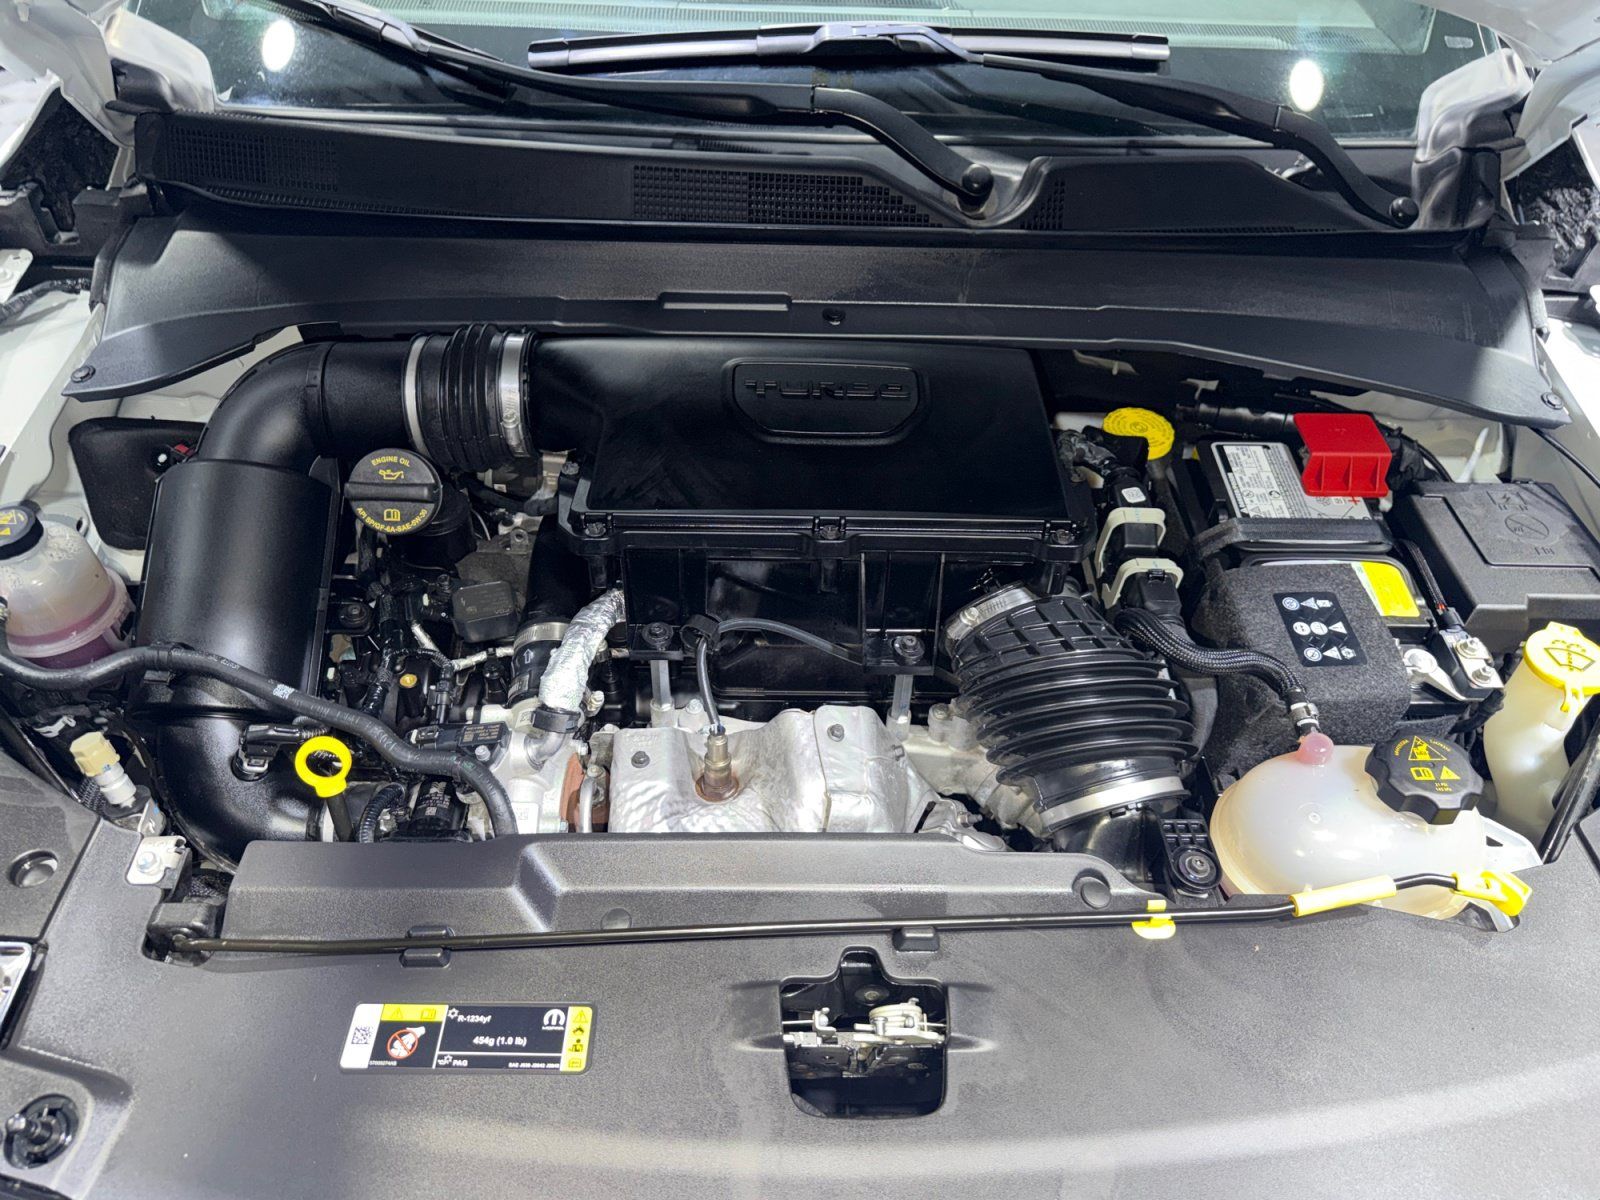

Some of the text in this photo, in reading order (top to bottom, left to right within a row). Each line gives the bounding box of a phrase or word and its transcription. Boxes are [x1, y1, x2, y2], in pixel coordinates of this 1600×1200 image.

[744, 379, 911, 401] TURBO
[371, 456, 410, 467] ENGINE OIL
[356, 507, 368, 519] API
[457, 1014, 492, 1024] R-1234yf
[472, 1036, 528, 1047] 454g (1.0 lb)
[451, 1058, 468, 1067] PAG
